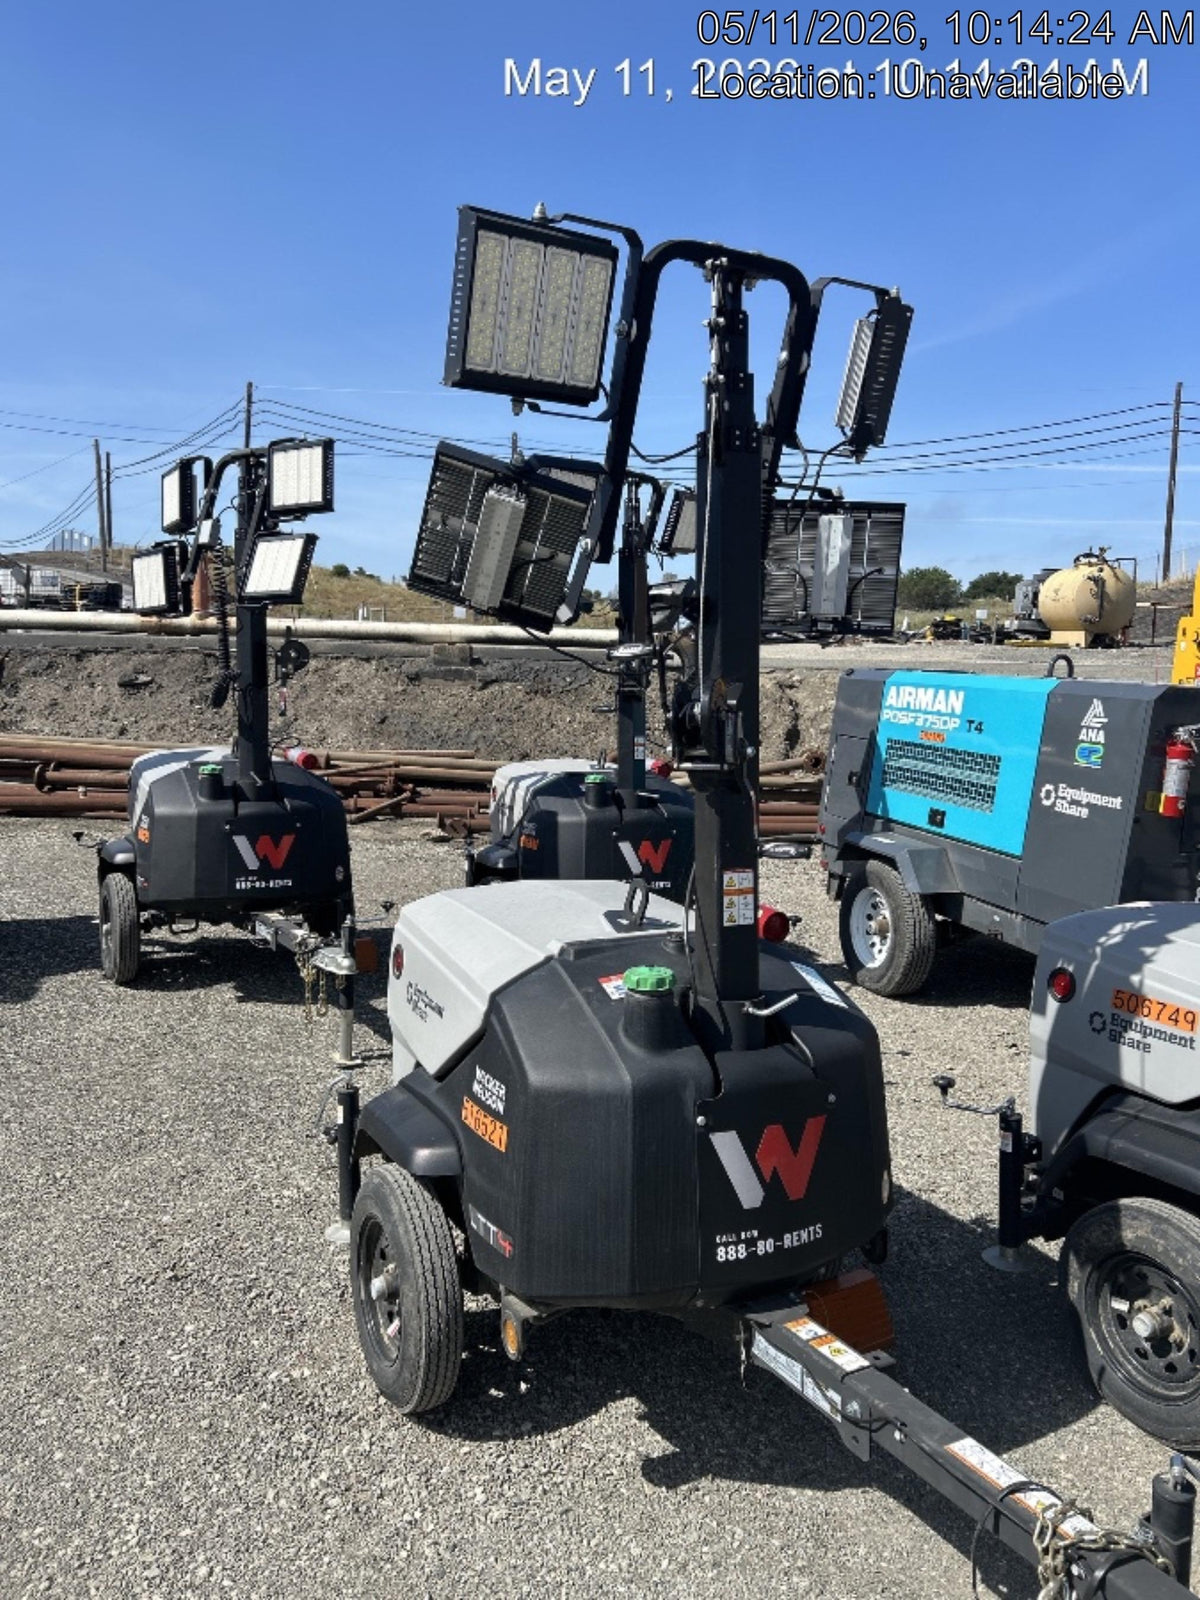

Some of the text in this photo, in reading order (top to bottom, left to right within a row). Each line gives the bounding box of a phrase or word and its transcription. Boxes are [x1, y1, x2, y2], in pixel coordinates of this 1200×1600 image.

[885, 685, 965, 715] AIRMAN
[966, 719, 984, 735] T4
[1079, 727, 1105, 744] ANA
[1054, 798, 1090, 819] Share
[1057, 783, 1123, 810] Equipment
[1111, 988, 1197, 1033] 506749
[1107, 1028, 1152, 1054] Share
[1109, 1012, 1196, 1050] Equipment
[716, 1223, 823, 1263] 888-80-RENTS
